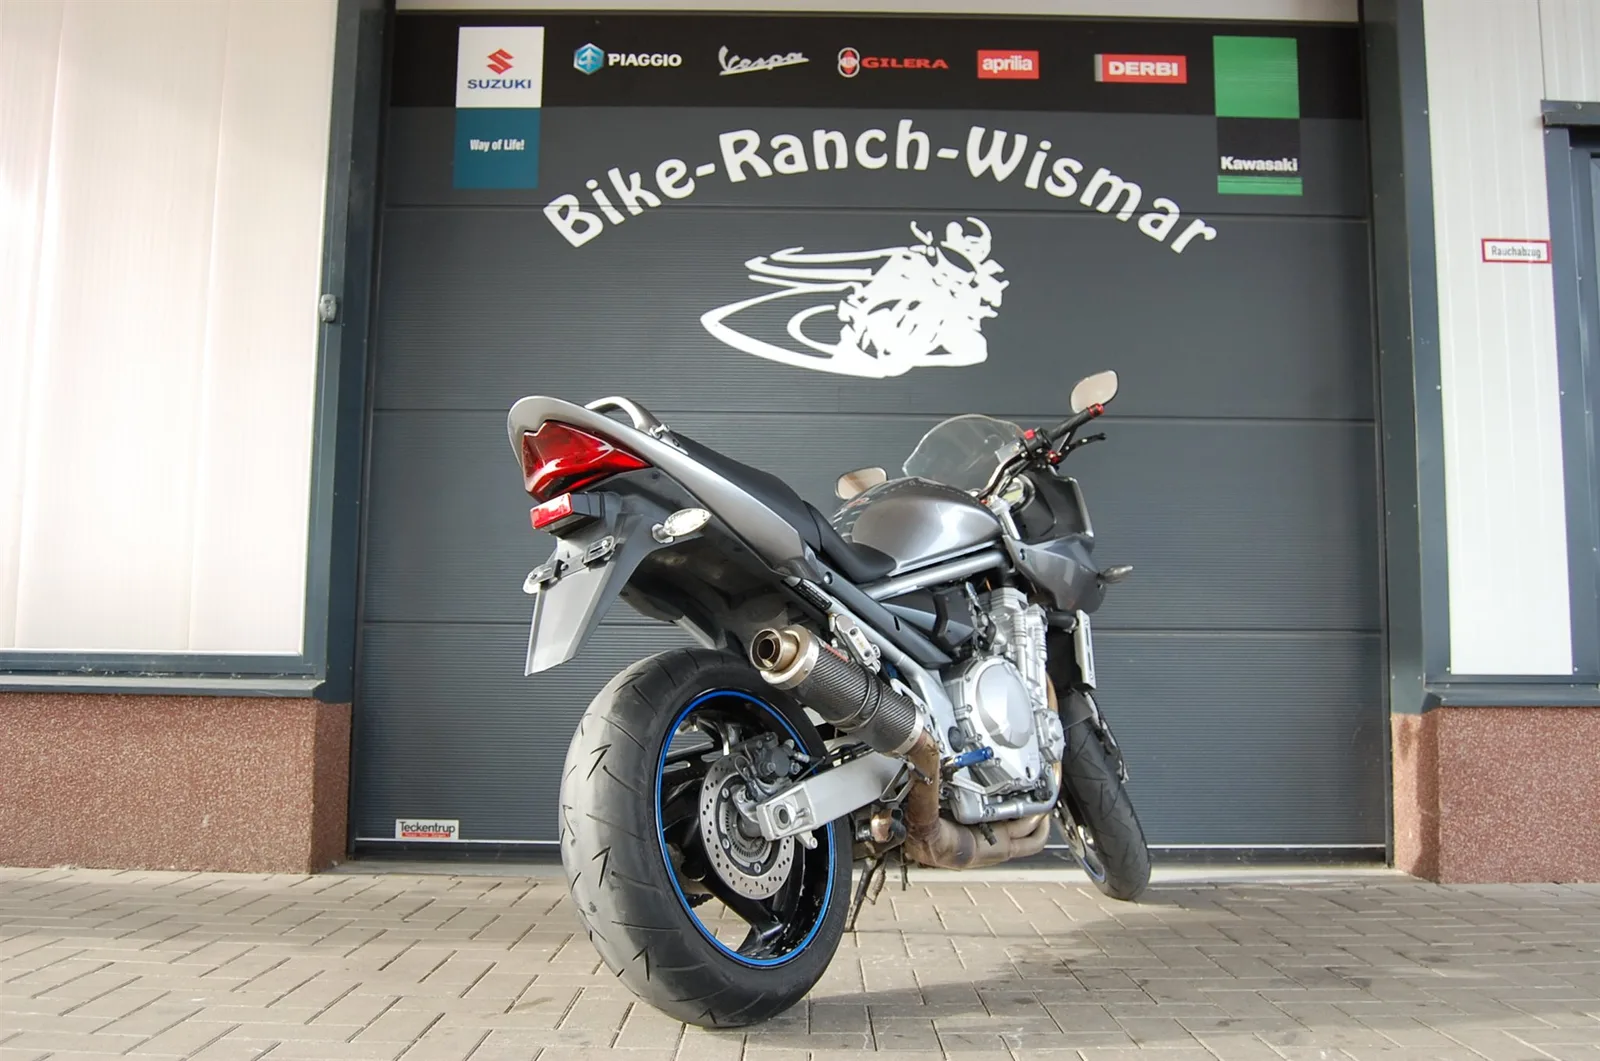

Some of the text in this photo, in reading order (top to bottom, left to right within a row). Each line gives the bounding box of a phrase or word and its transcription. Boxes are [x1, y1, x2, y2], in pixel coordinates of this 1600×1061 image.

[608, 53, 683, 67] PIAGGIO
[718, 45, 809, 76] Vespa
[861, 56, 949, 69] GILERA
[982, 55, 1033, 73] aprilia
[1108, 61, 1179, 76] DERBI
[467, 79, 532, 89] SUZUKI
[470, 139, 525, 153] Way of Life!
[1220, 156, 1298, 171] Kawasaki
[1491, 245, 1542, 259] Rauchabzug
[399, 821, 456, 837] Teckentrup
